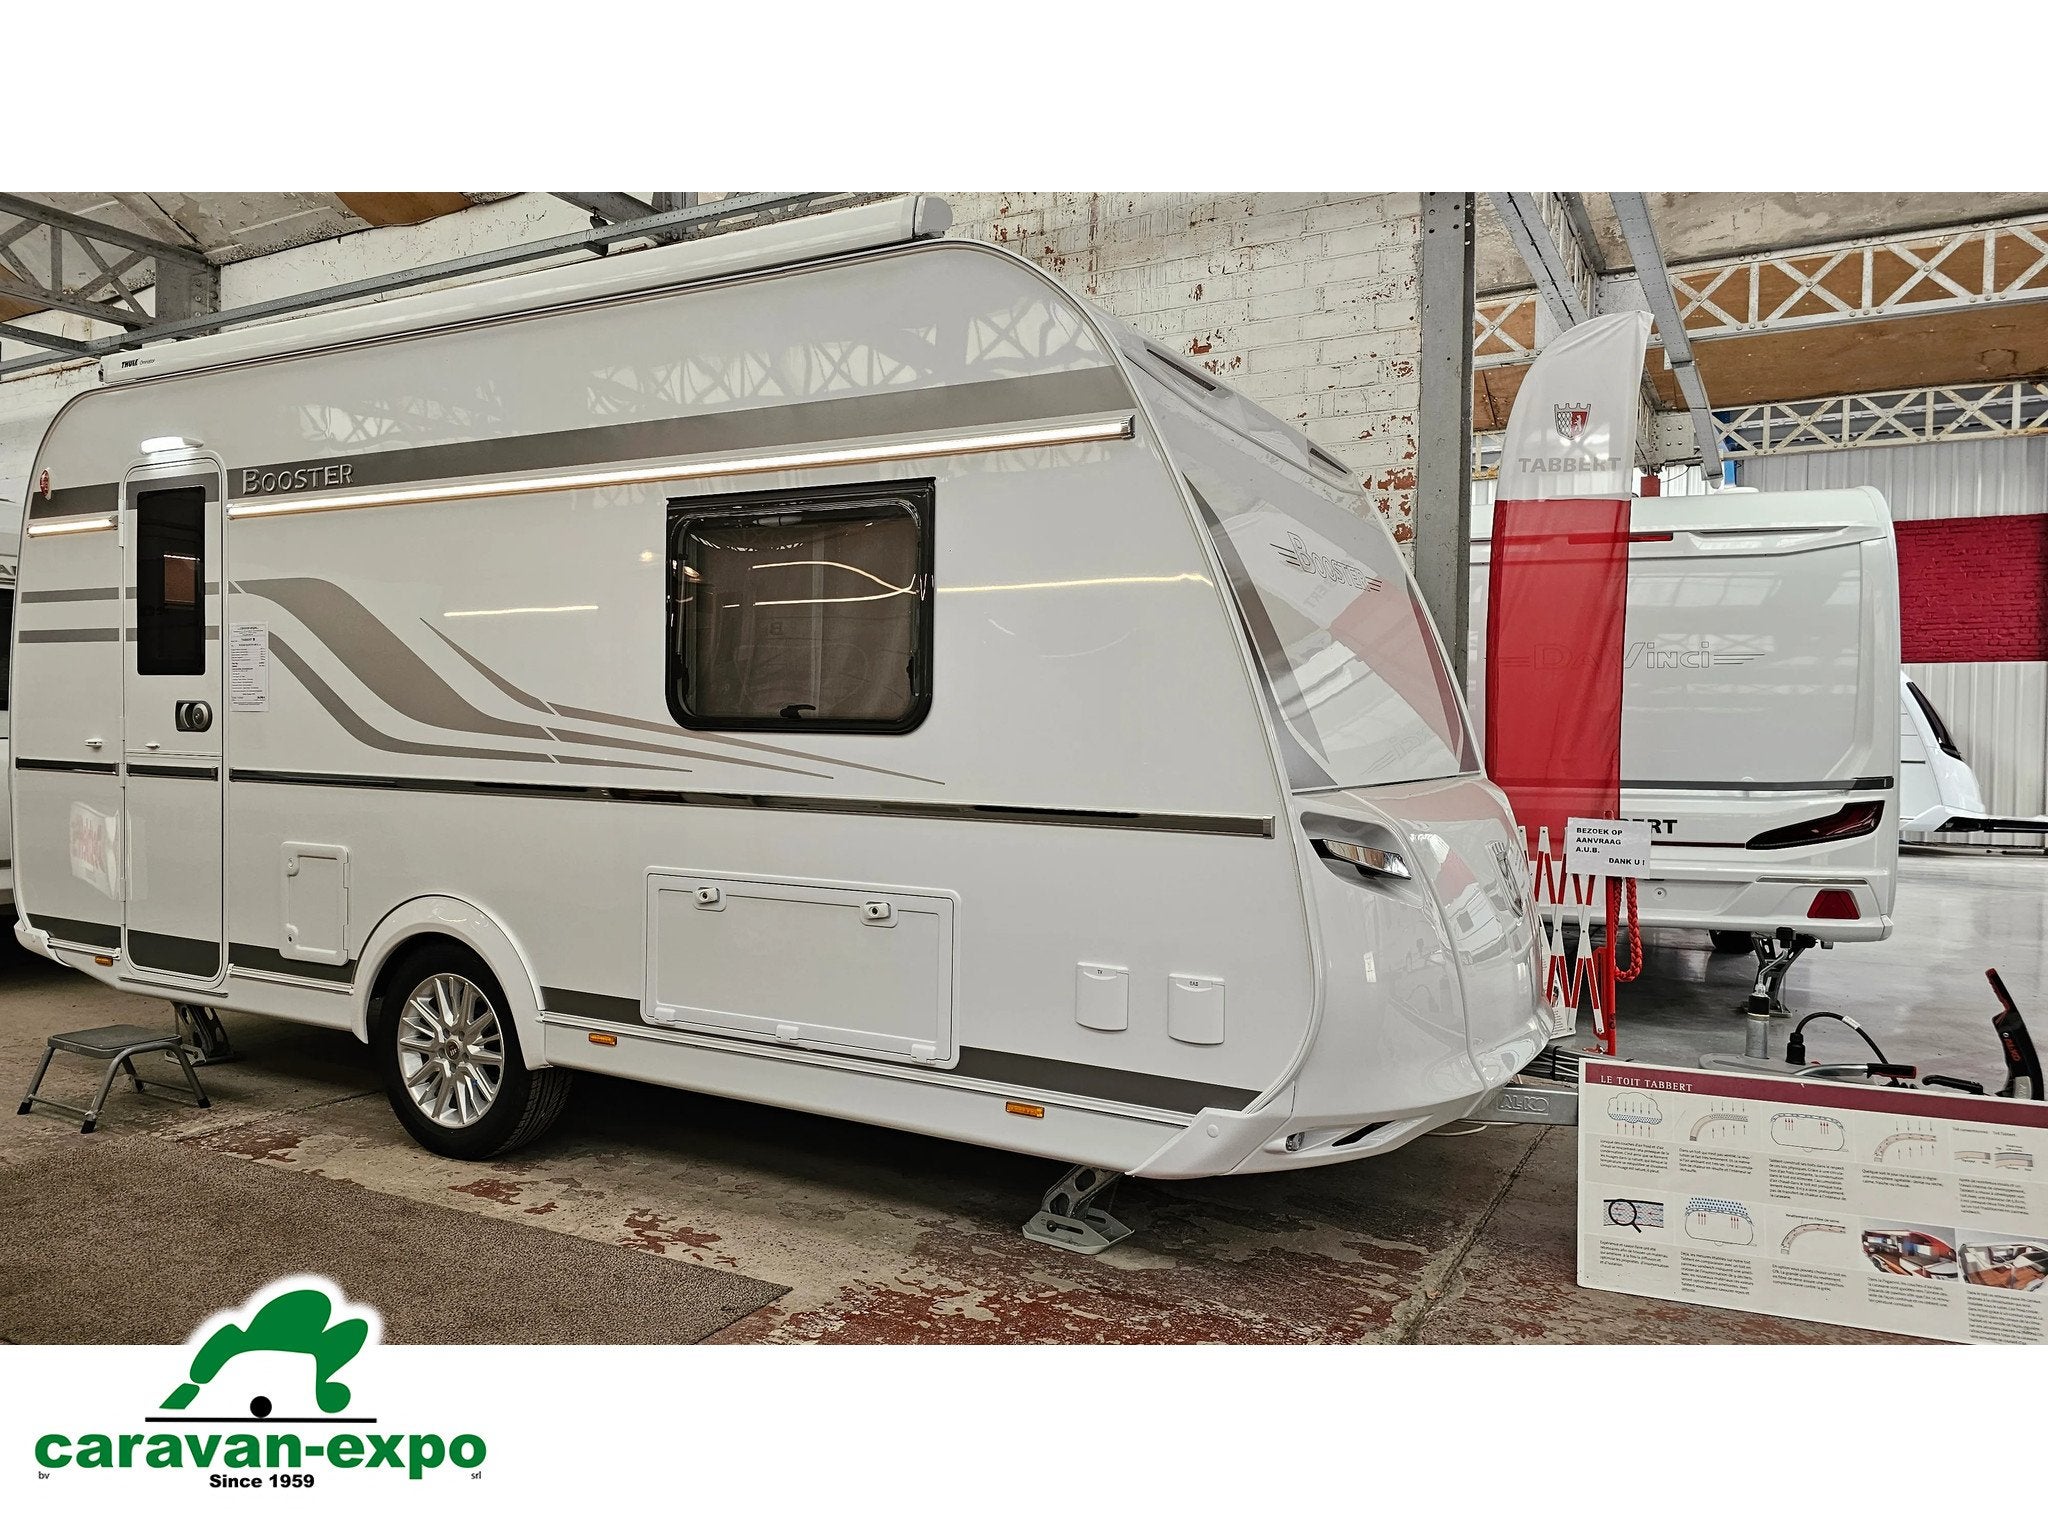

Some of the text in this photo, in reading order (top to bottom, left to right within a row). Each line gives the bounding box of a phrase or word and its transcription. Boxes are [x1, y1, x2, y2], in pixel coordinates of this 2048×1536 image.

[1518, 456, 1622, 473] TABBERT
[242, 463, 355, 495] BOOSTER
[1576, 827, 1609, 835] BEZOEK
[1575, 837, 1622, 845] AANVRAAG
[1575, 846, 1600, 854] A.U.B.
[1608, 857, 1632, 865] DANK
[1600, 1074, 1693, 1092] LE TOIT TABBERT
